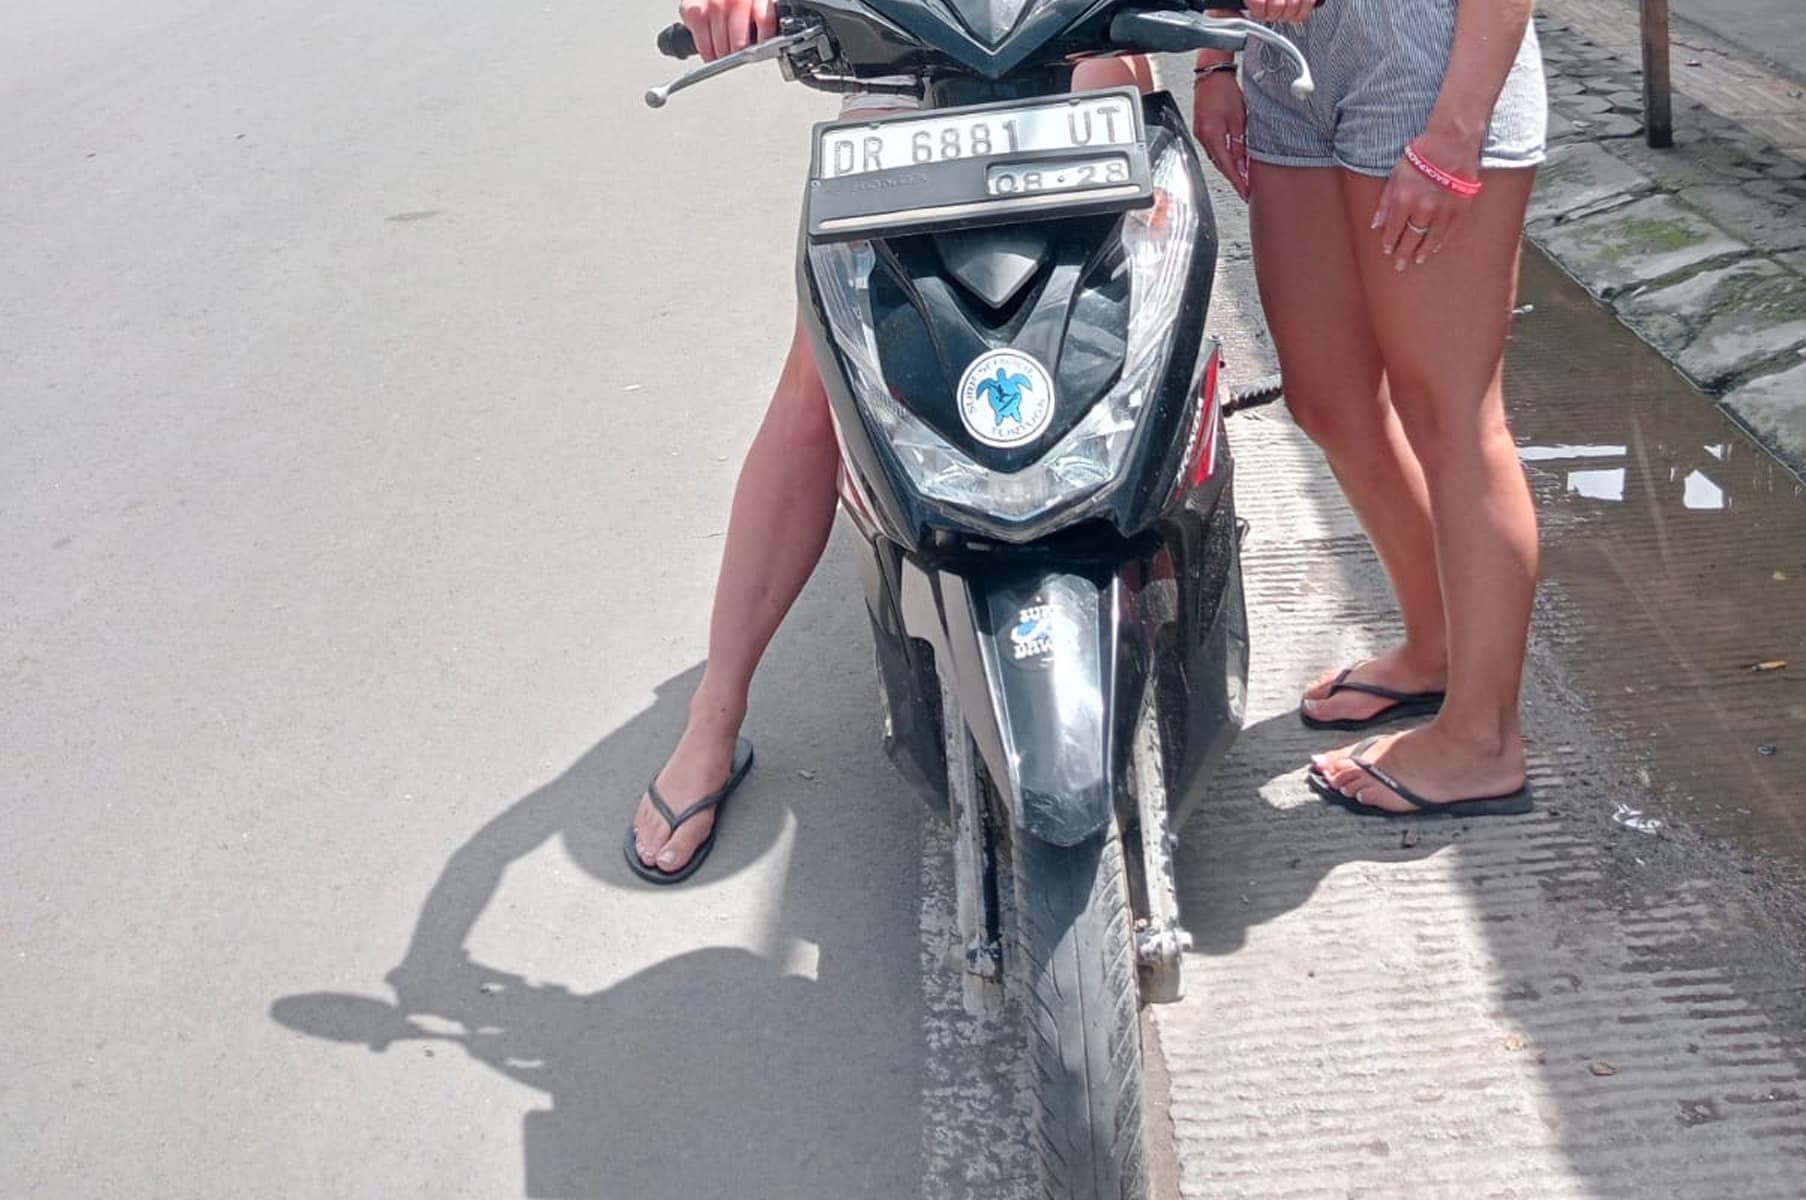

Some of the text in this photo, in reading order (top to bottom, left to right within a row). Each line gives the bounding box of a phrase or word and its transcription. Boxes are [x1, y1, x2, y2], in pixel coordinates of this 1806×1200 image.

[833, 106, 1122, 175] DR 6881 UT
